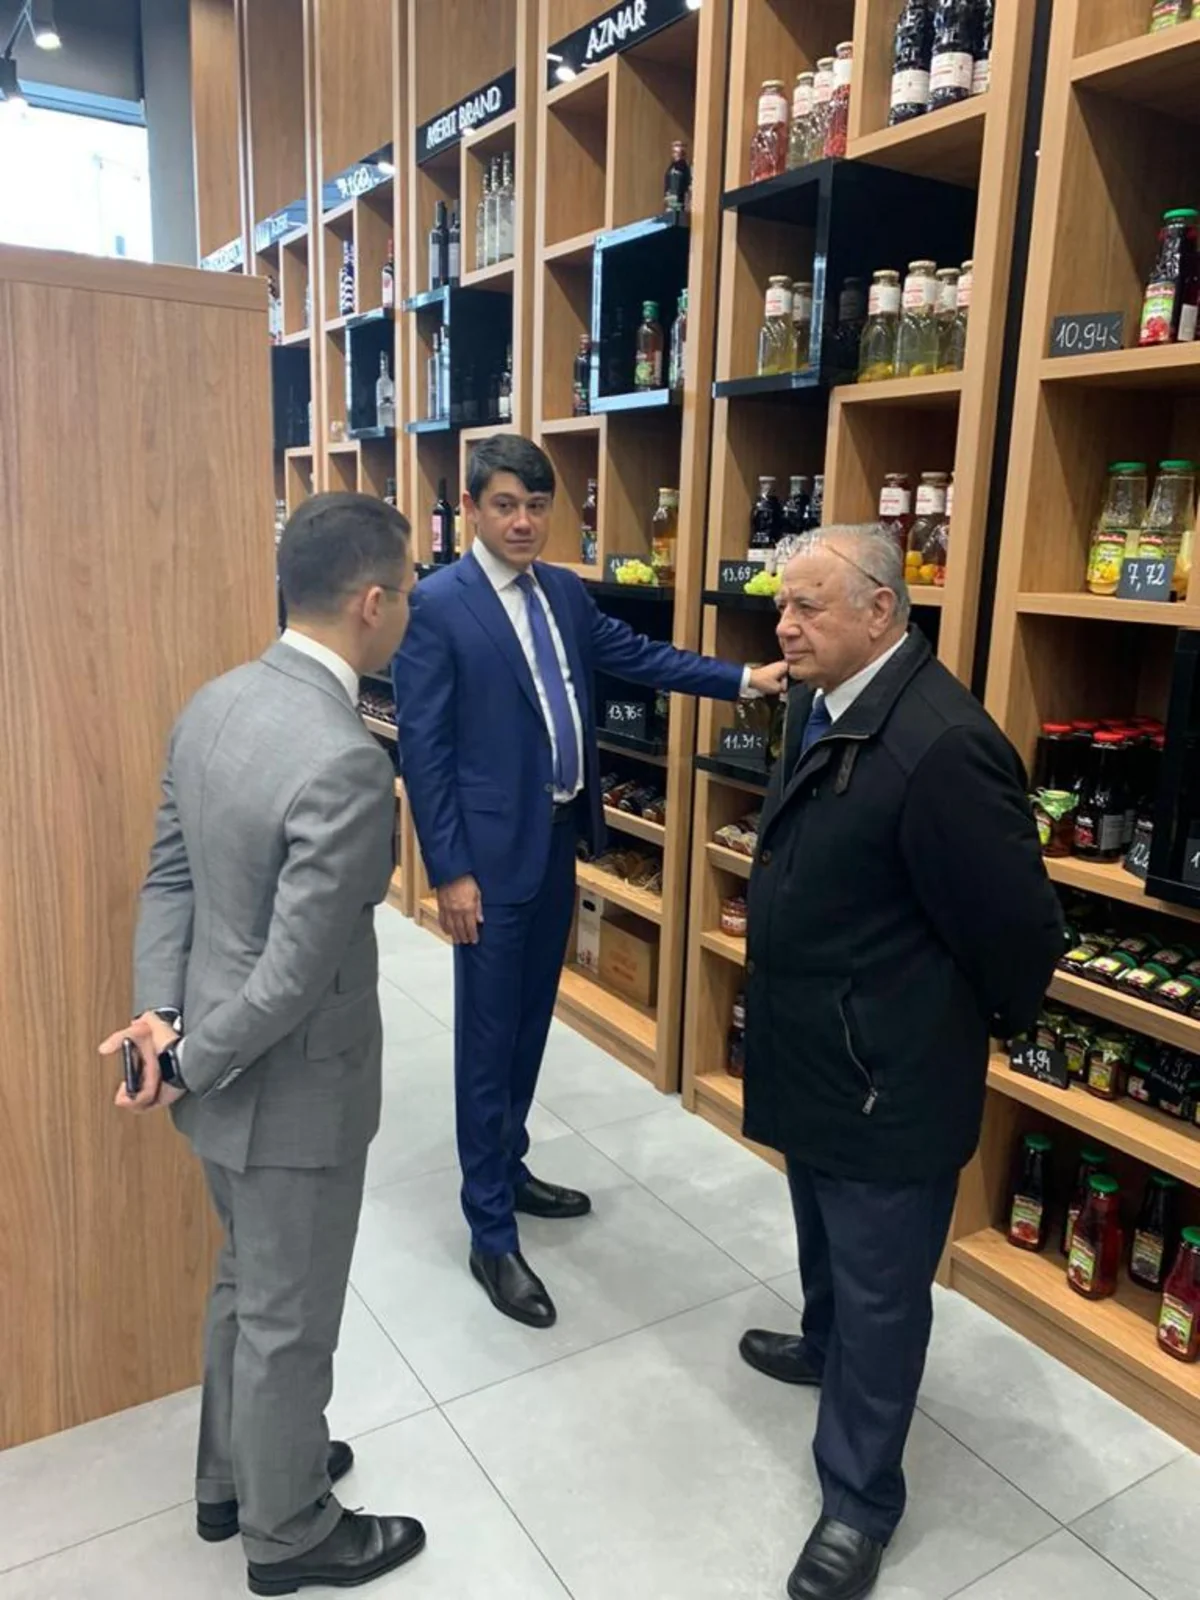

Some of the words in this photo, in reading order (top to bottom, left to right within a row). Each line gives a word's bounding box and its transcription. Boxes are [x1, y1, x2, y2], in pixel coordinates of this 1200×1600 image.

[586, 0, 647, 59] AZNAR
[425, 110, 457, 149] MERIT
[458, 86, 502, 130] BRAND
[1127, 562, 1166, 592] 7,72
